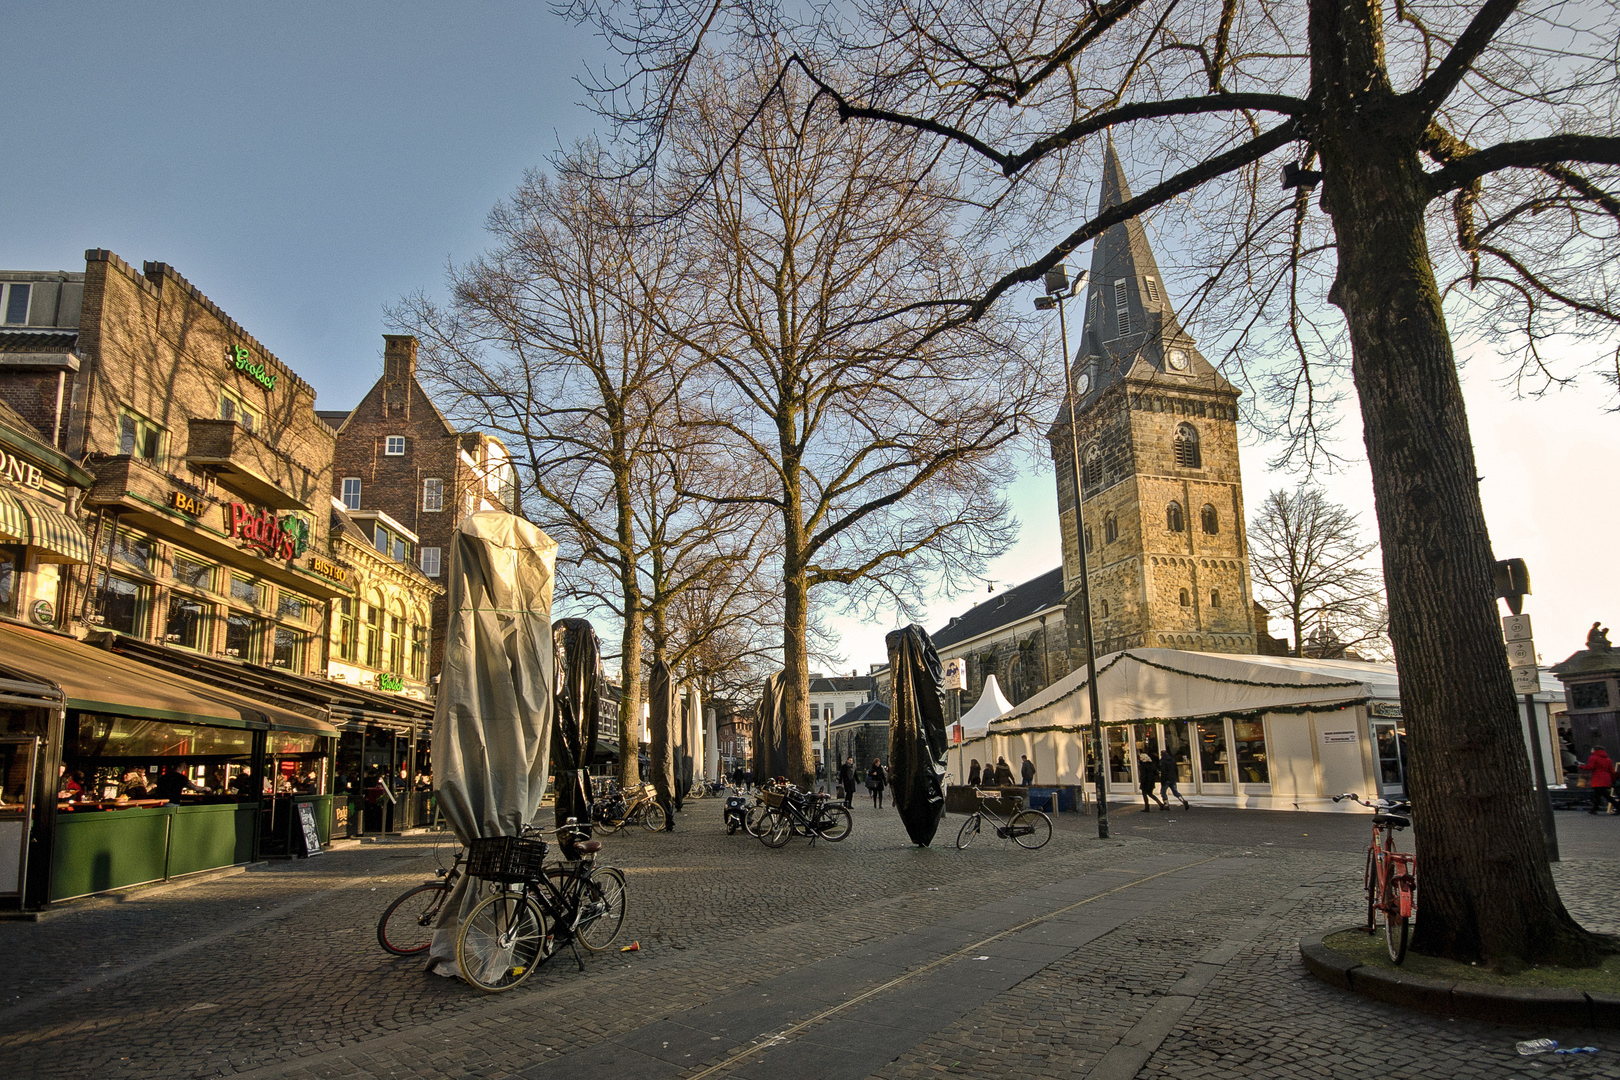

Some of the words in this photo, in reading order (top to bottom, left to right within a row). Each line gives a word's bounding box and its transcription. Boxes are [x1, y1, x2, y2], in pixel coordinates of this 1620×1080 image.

[235, 344, 278, 391] Grolsch
[175, 491, 205, 516] BAR
[230, 502, 294, 560] Paddy's
[314, 558, 346, 581] BISTRO
